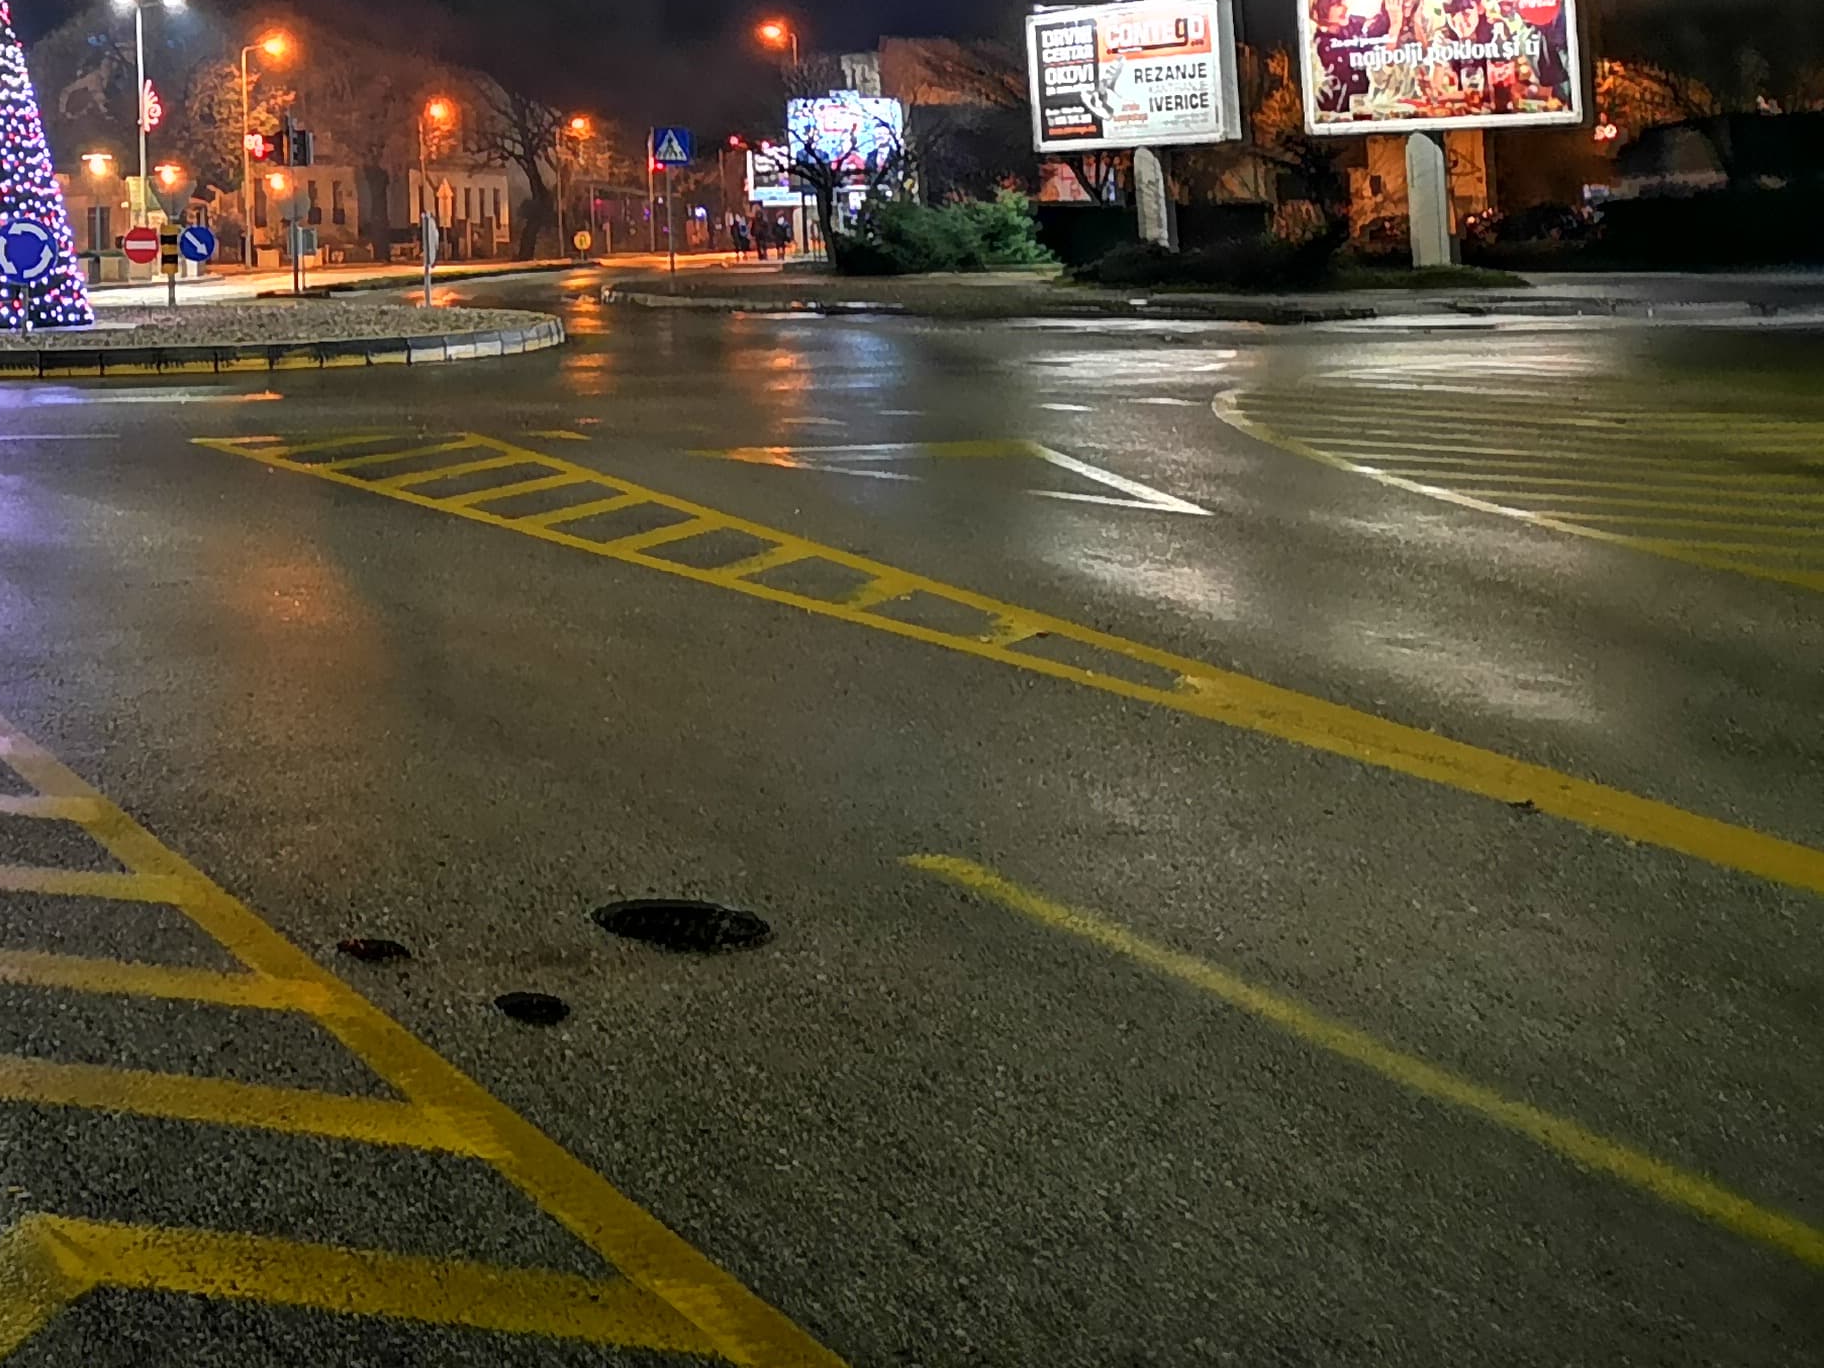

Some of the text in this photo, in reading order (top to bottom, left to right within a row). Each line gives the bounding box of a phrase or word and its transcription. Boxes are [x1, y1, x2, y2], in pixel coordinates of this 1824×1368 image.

[1349, 43, 1423, 72] najbolji
[1425, 38, 1499, 66] poklon
[1044, 63, 1094, 86] OKOVI
[1133, 62, 1208, 84] REZANJE
[1148, 92, 1210, 113] IVERICE
